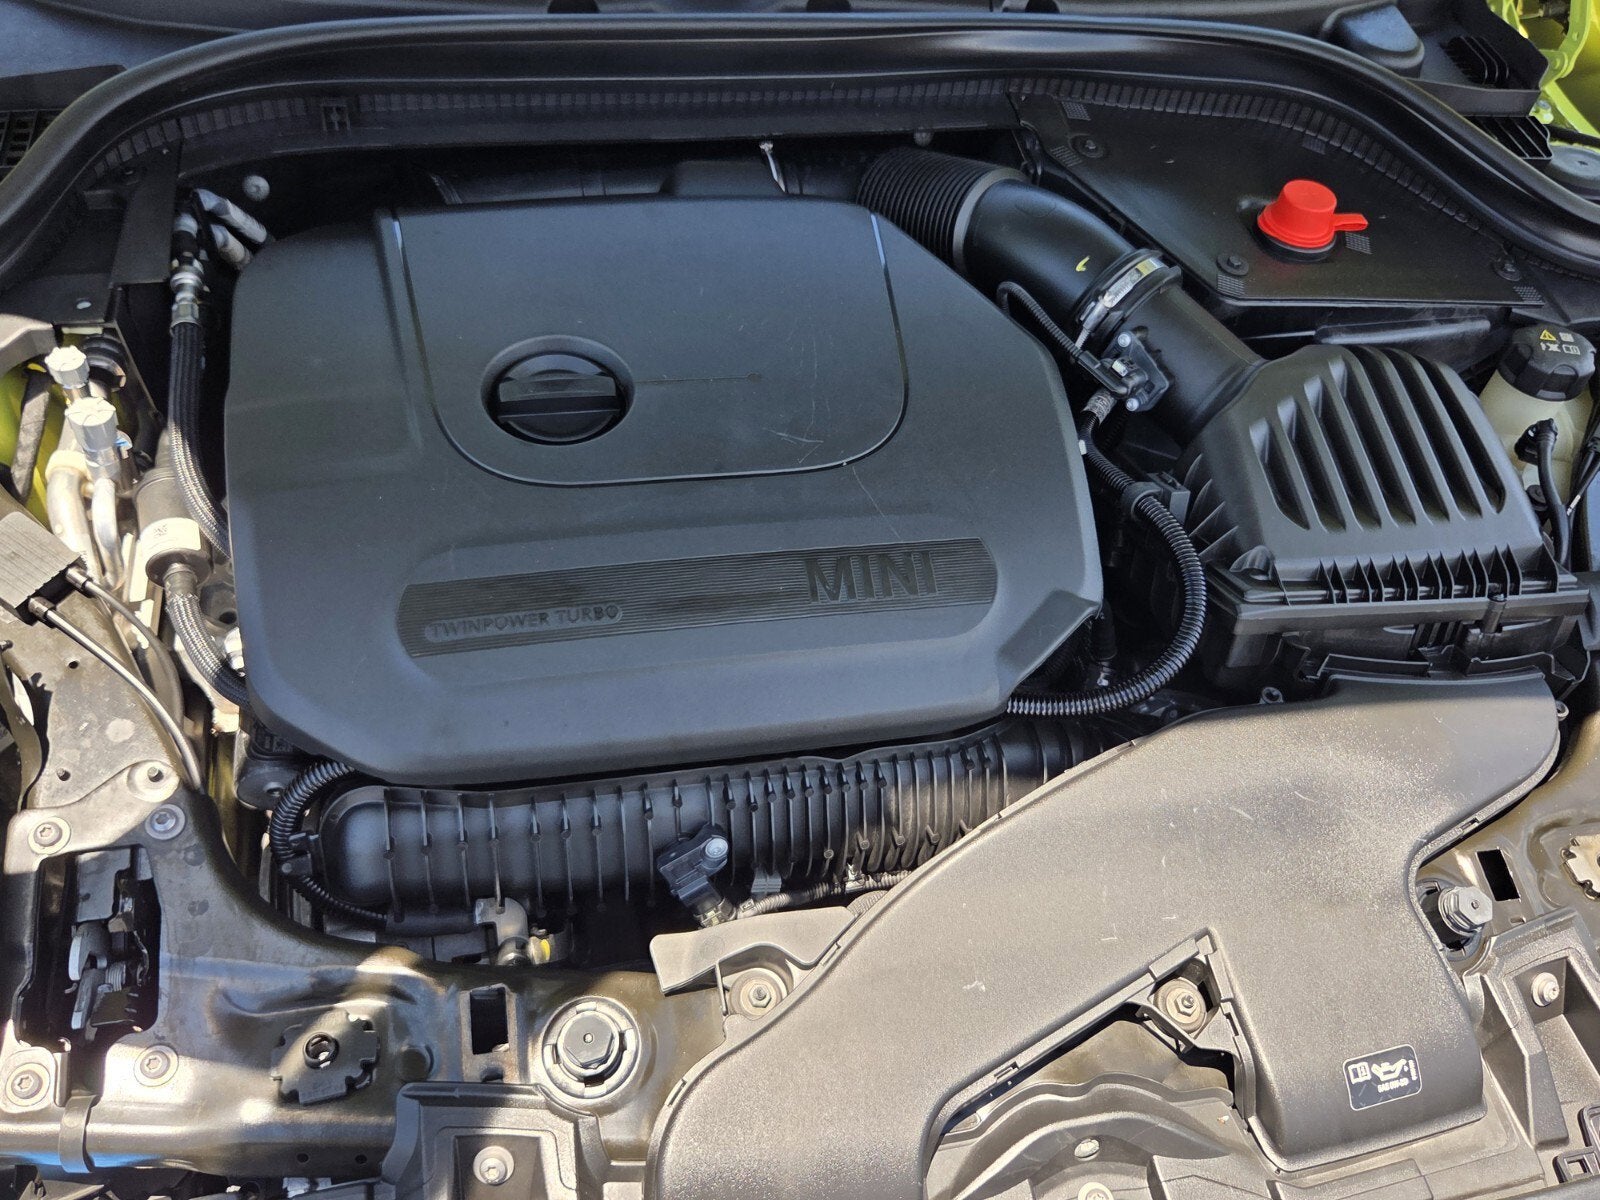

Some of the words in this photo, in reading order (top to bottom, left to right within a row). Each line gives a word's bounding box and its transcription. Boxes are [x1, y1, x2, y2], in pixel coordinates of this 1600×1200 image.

[804, 552, 938, 603] MINI
[431, 611, 550, 638] TWINPOWER
[555, 604, 619, 624] TURBO
